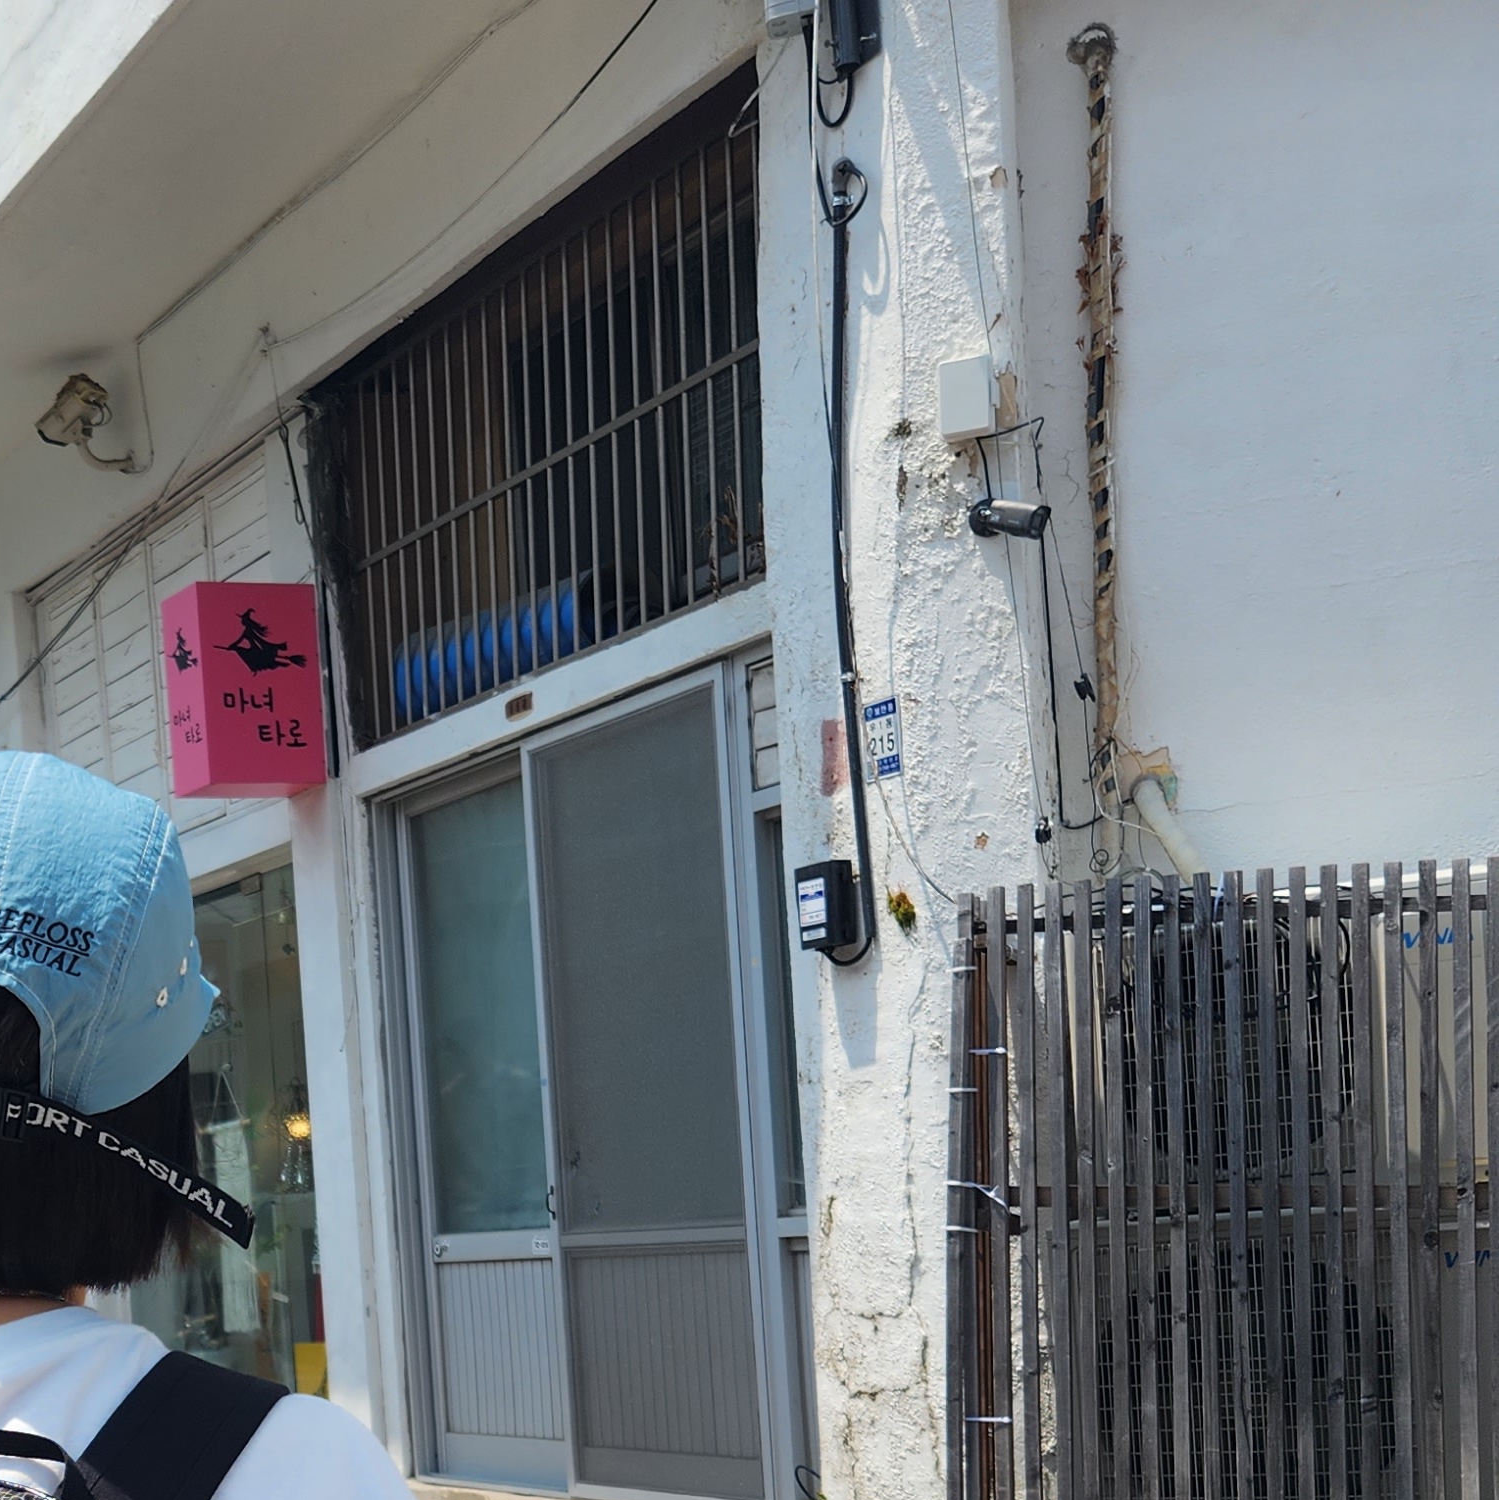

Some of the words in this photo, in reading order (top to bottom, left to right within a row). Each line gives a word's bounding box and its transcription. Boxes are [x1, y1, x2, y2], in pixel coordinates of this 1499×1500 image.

[222, 687, 274, 714] 마녀
[173, 704, 191, 727] 마녀
[185, 723, 203, 744] 타로
[257, 719, 307, 748] 타로
[867, 732, 895, 757] 215
[97, 1130, 234, 1229] CASUAL
